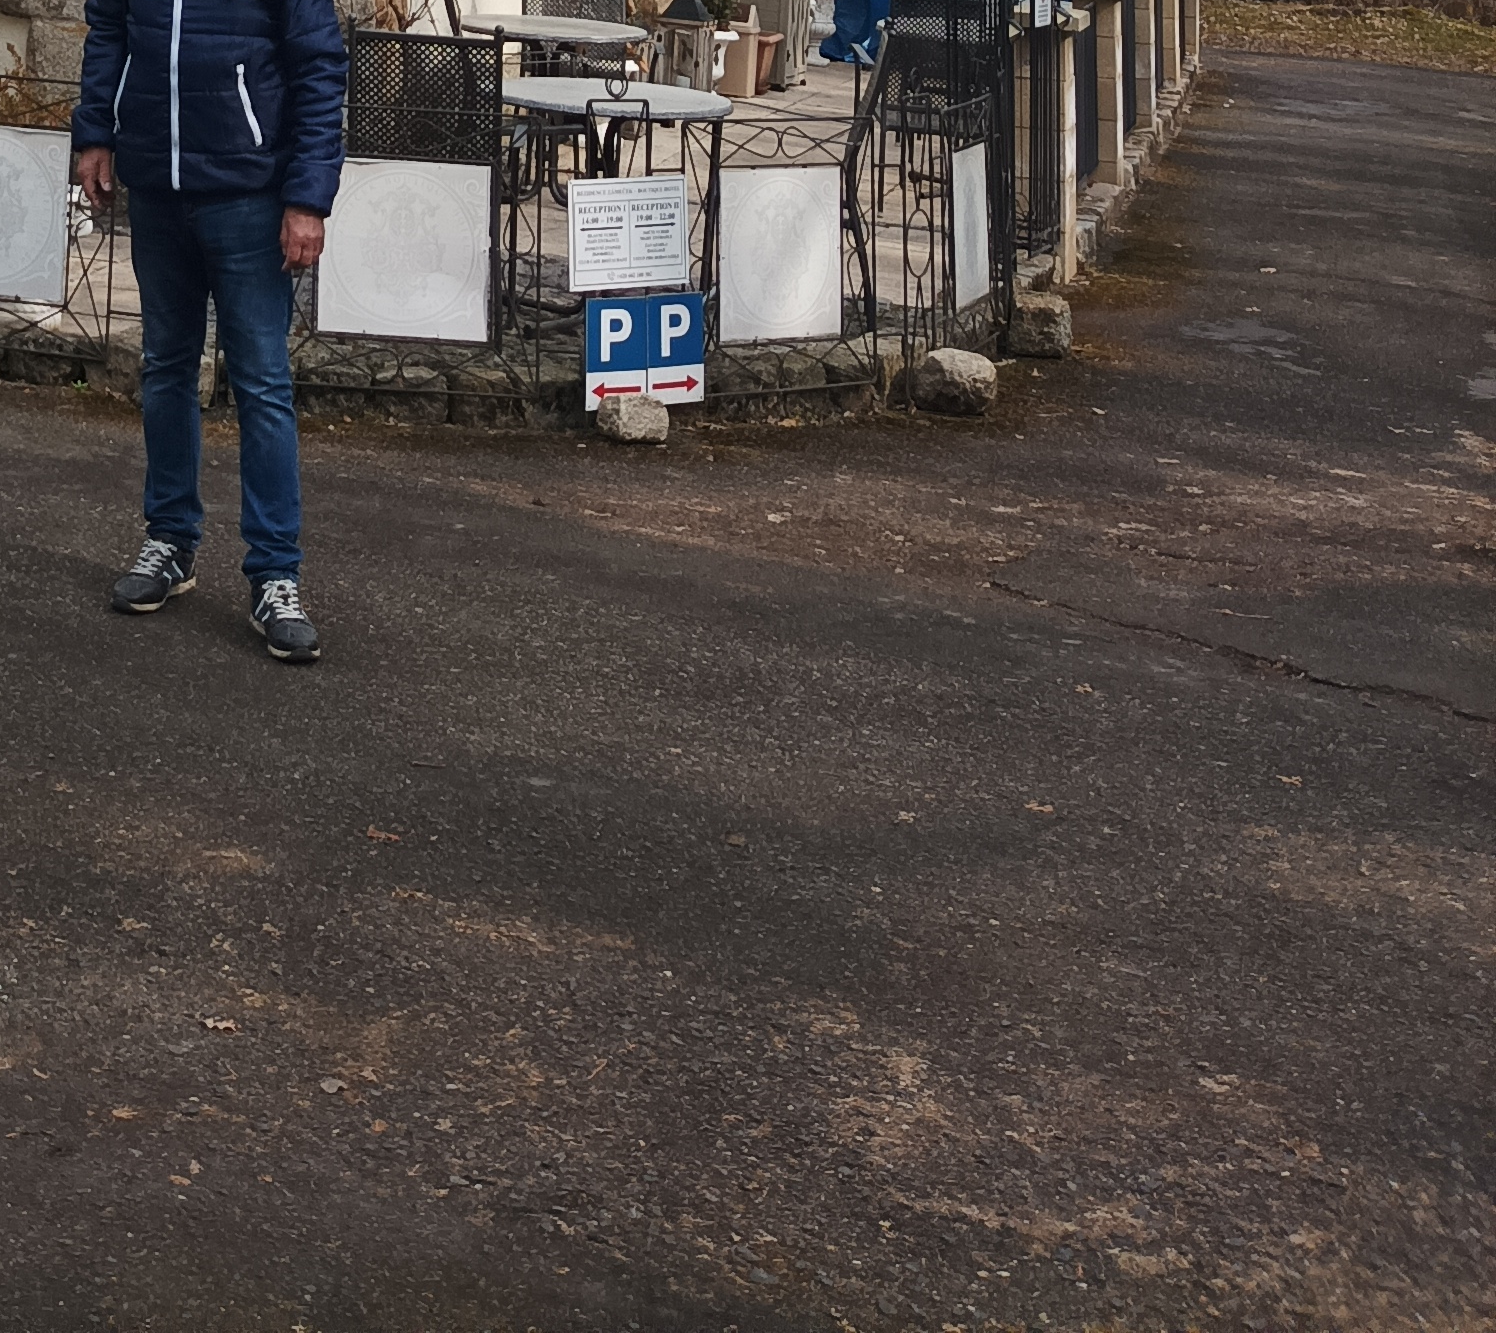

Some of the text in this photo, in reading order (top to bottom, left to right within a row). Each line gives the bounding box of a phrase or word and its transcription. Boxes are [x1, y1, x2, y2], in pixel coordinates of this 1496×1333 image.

[578, 205, 621, 215] RECEPTION
[631, 202, 672, 212] RECEPTION
[600, 308, 633, 363] P
[660, 303, 691, 358] P
